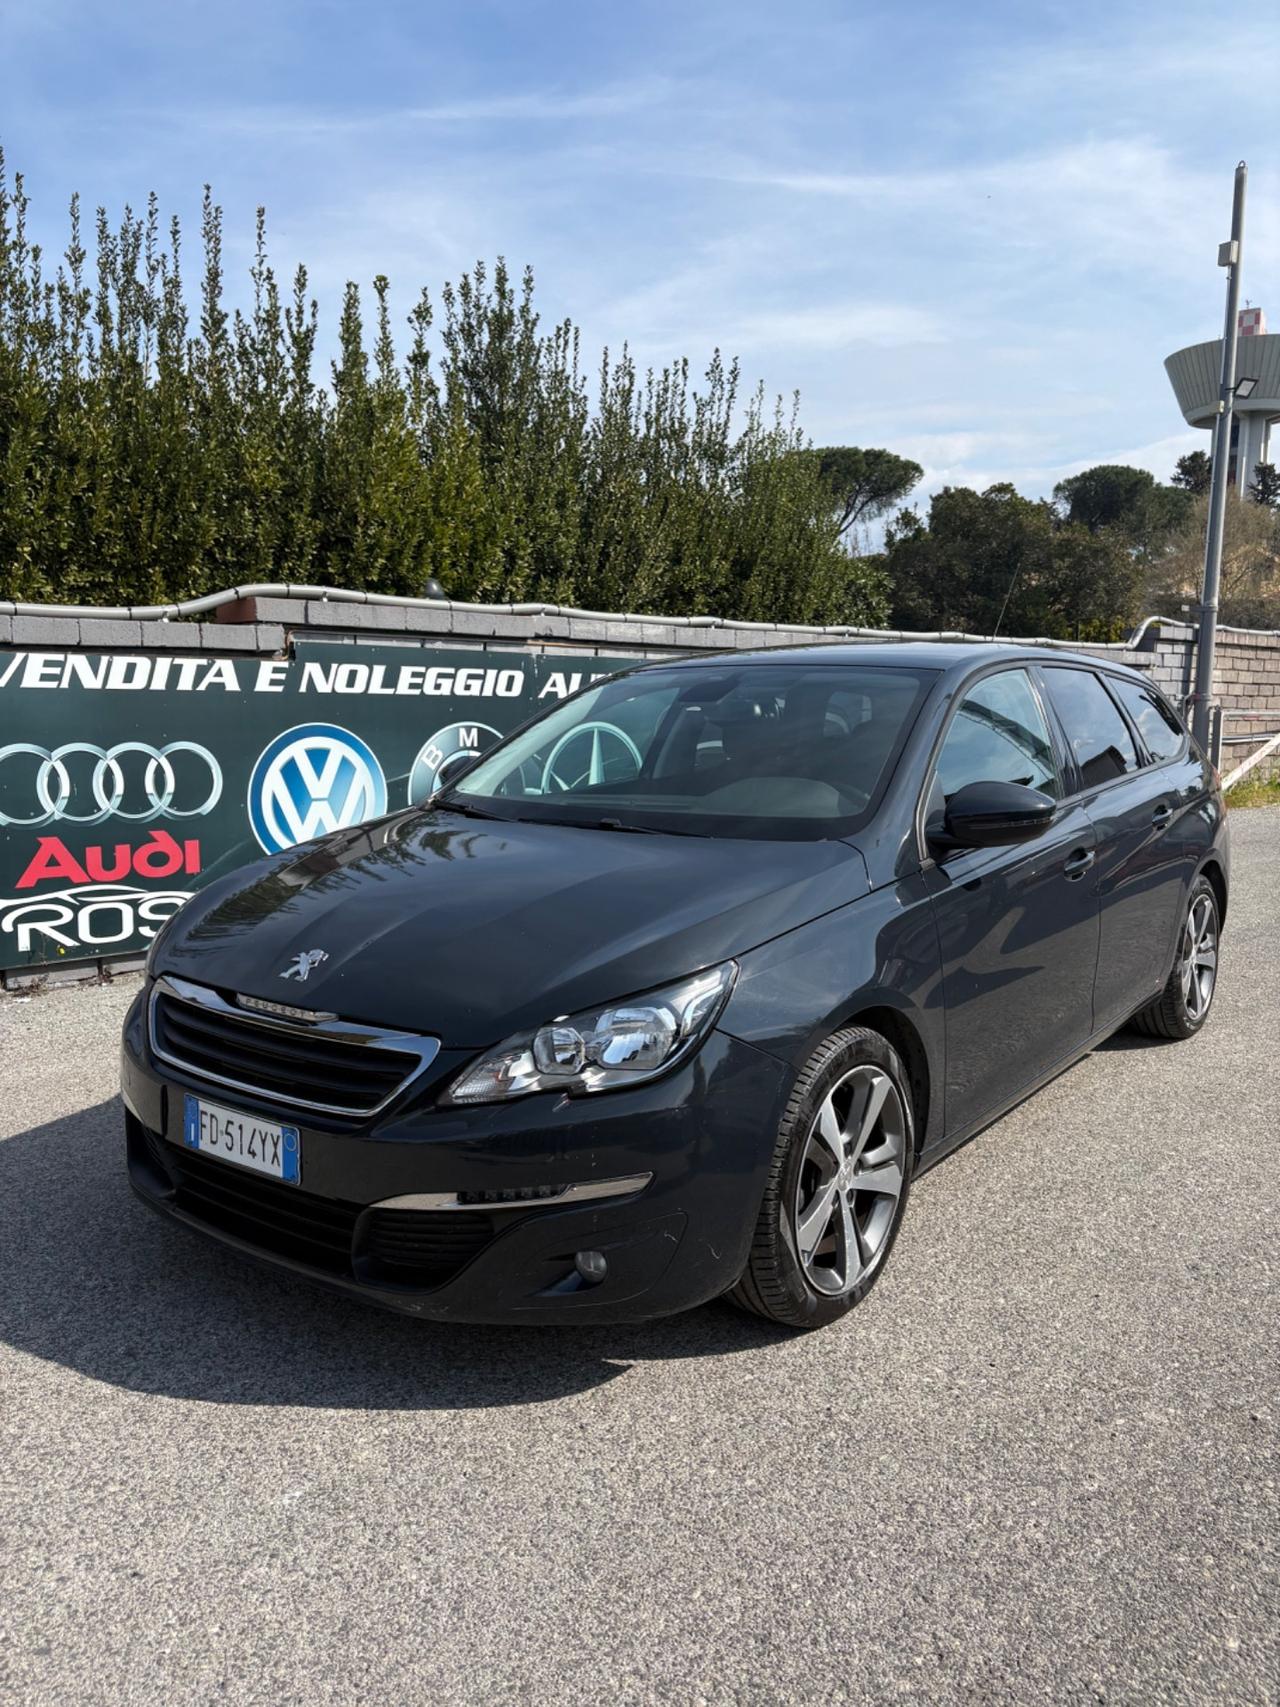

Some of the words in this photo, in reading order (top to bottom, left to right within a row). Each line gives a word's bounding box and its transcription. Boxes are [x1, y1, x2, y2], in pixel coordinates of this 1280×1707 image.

[254, 660, 289, 692] E
[298, 662, 524, 697] NOLEGGIO
[15, 830, 201, 889] Audi
